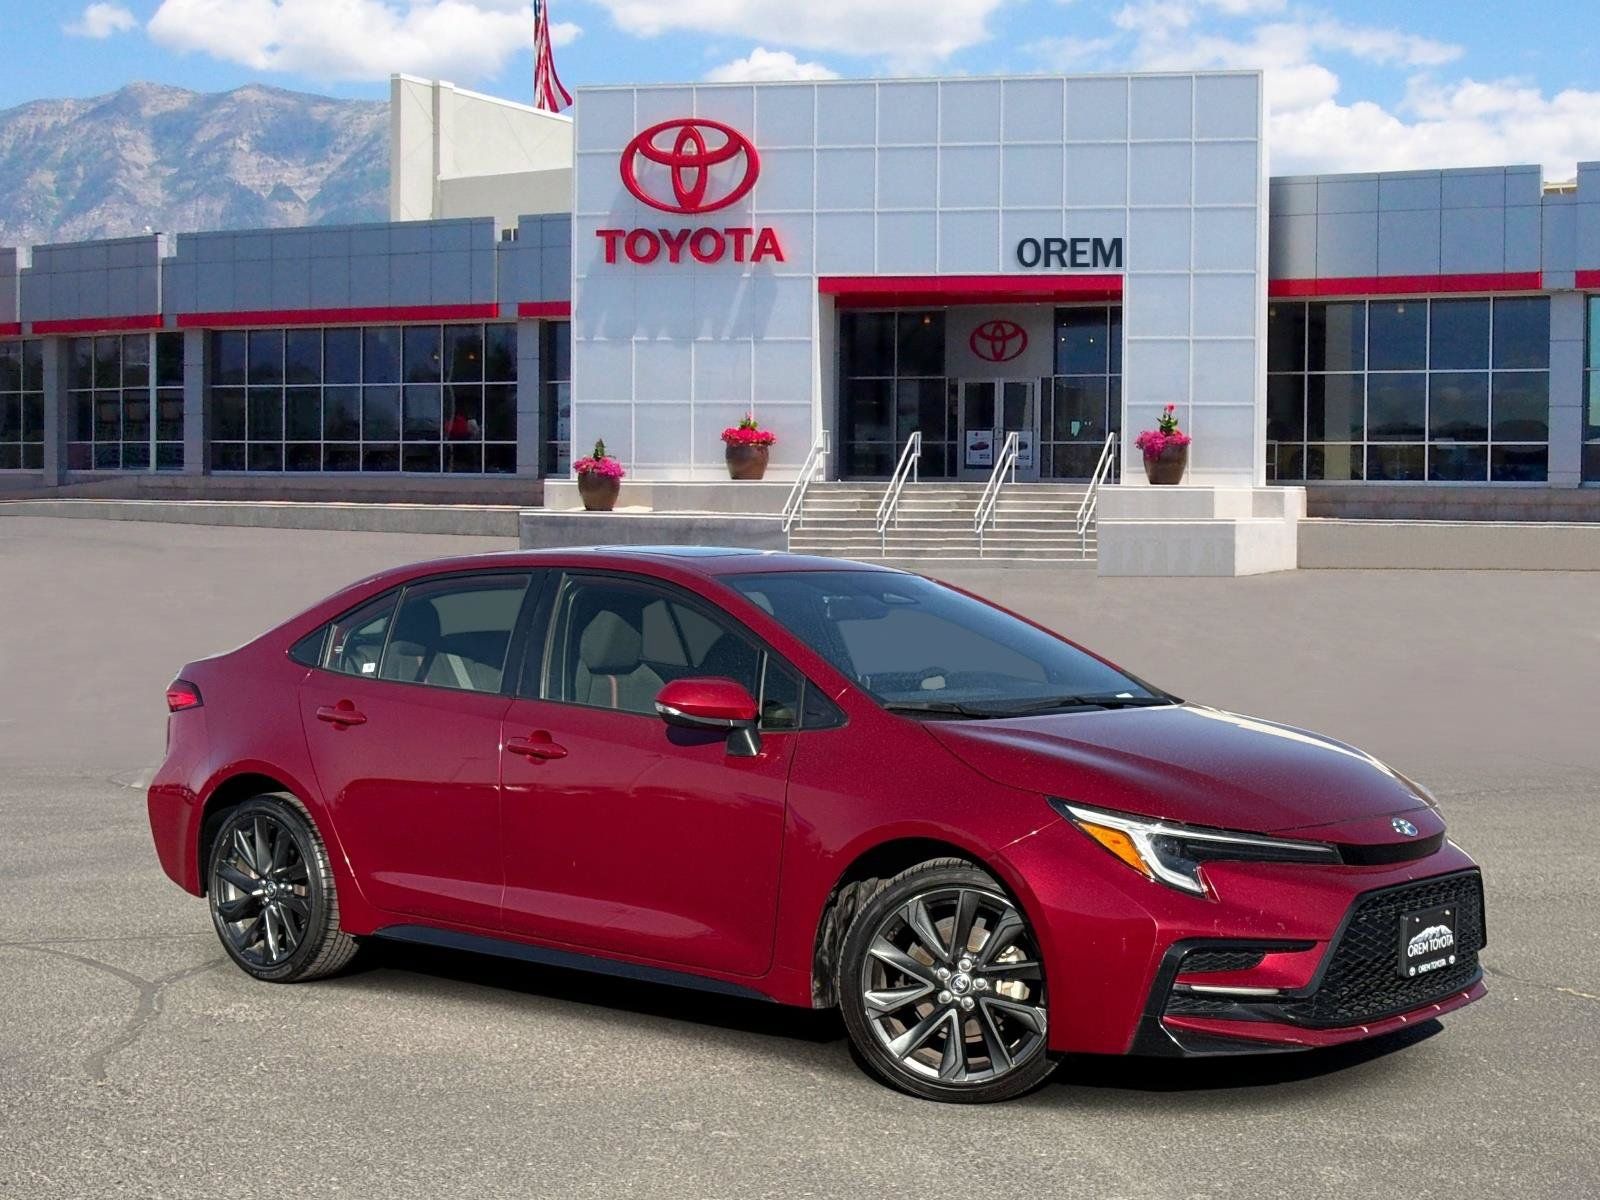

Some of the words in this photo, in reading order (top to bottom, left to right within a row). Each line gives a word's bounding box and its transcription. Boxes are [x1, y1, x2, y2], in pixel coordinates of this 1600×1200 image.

[596, 227, 785, 265] TOYOTA
[1016, 237, 1123, 268] OREM
[1407, 941, 1429, 957] OREM
[1429, 934, 1454, 951] TOYOTA
[1418, 962, 1430, 973] OREM
[1430, 958, 1446, 969] TOYOTA
